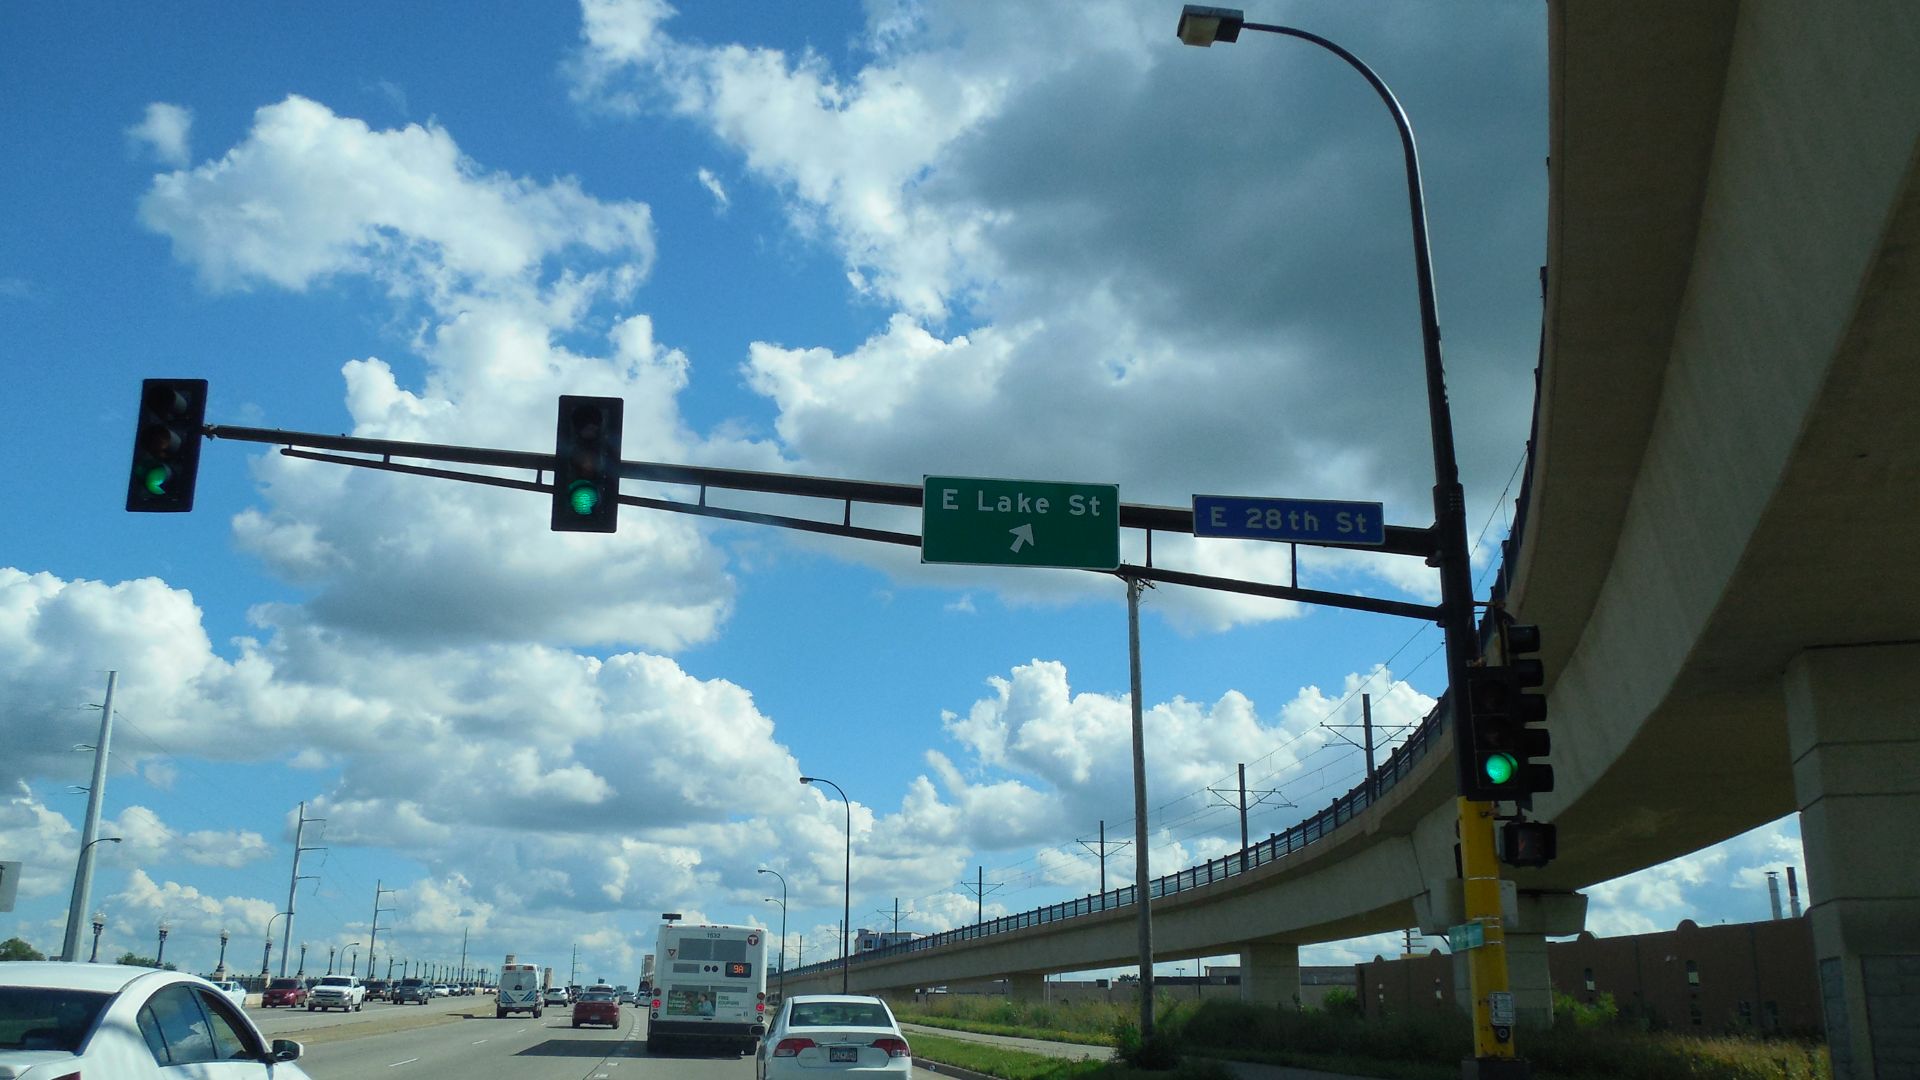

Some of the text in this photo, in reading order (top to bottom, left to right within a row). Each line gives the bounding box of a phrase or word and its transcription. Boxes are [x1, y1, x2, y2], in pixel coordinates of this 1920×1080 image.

[943, 488, 1101, 517] E Lake St
[1210, 506, 1367, 534] E 28th St
